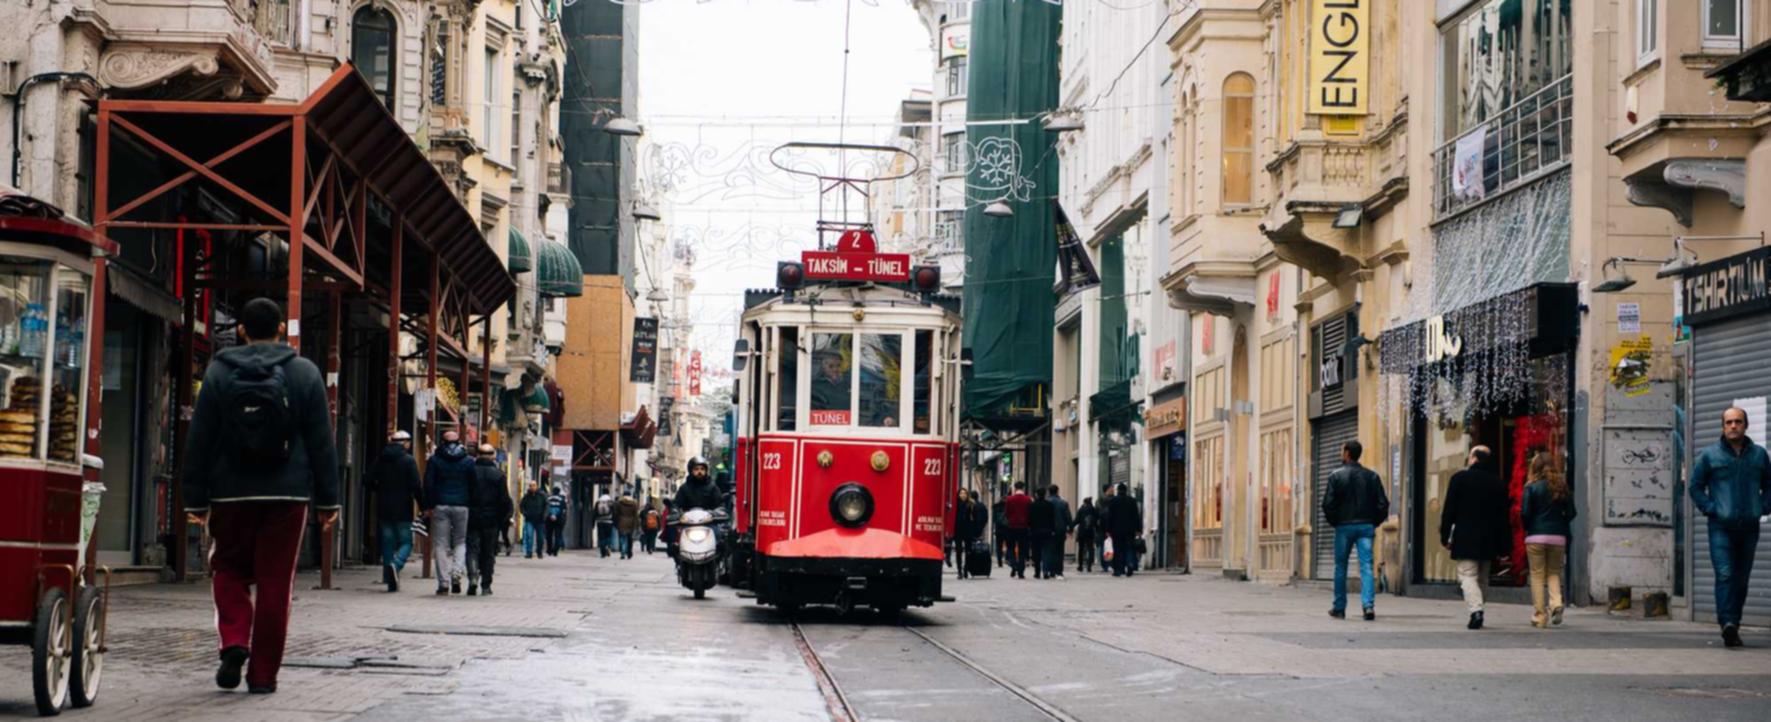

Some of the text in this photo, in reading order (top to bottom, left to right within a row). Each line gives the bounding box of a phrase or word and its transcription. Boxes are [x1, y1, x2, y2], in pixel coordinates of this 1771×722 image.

[852, 231, 861, 248] 2
[867, 258, 906, 276] TÜNEL
[763, 452, 781, 470] 223
[924, 458, 941, 475] 223
